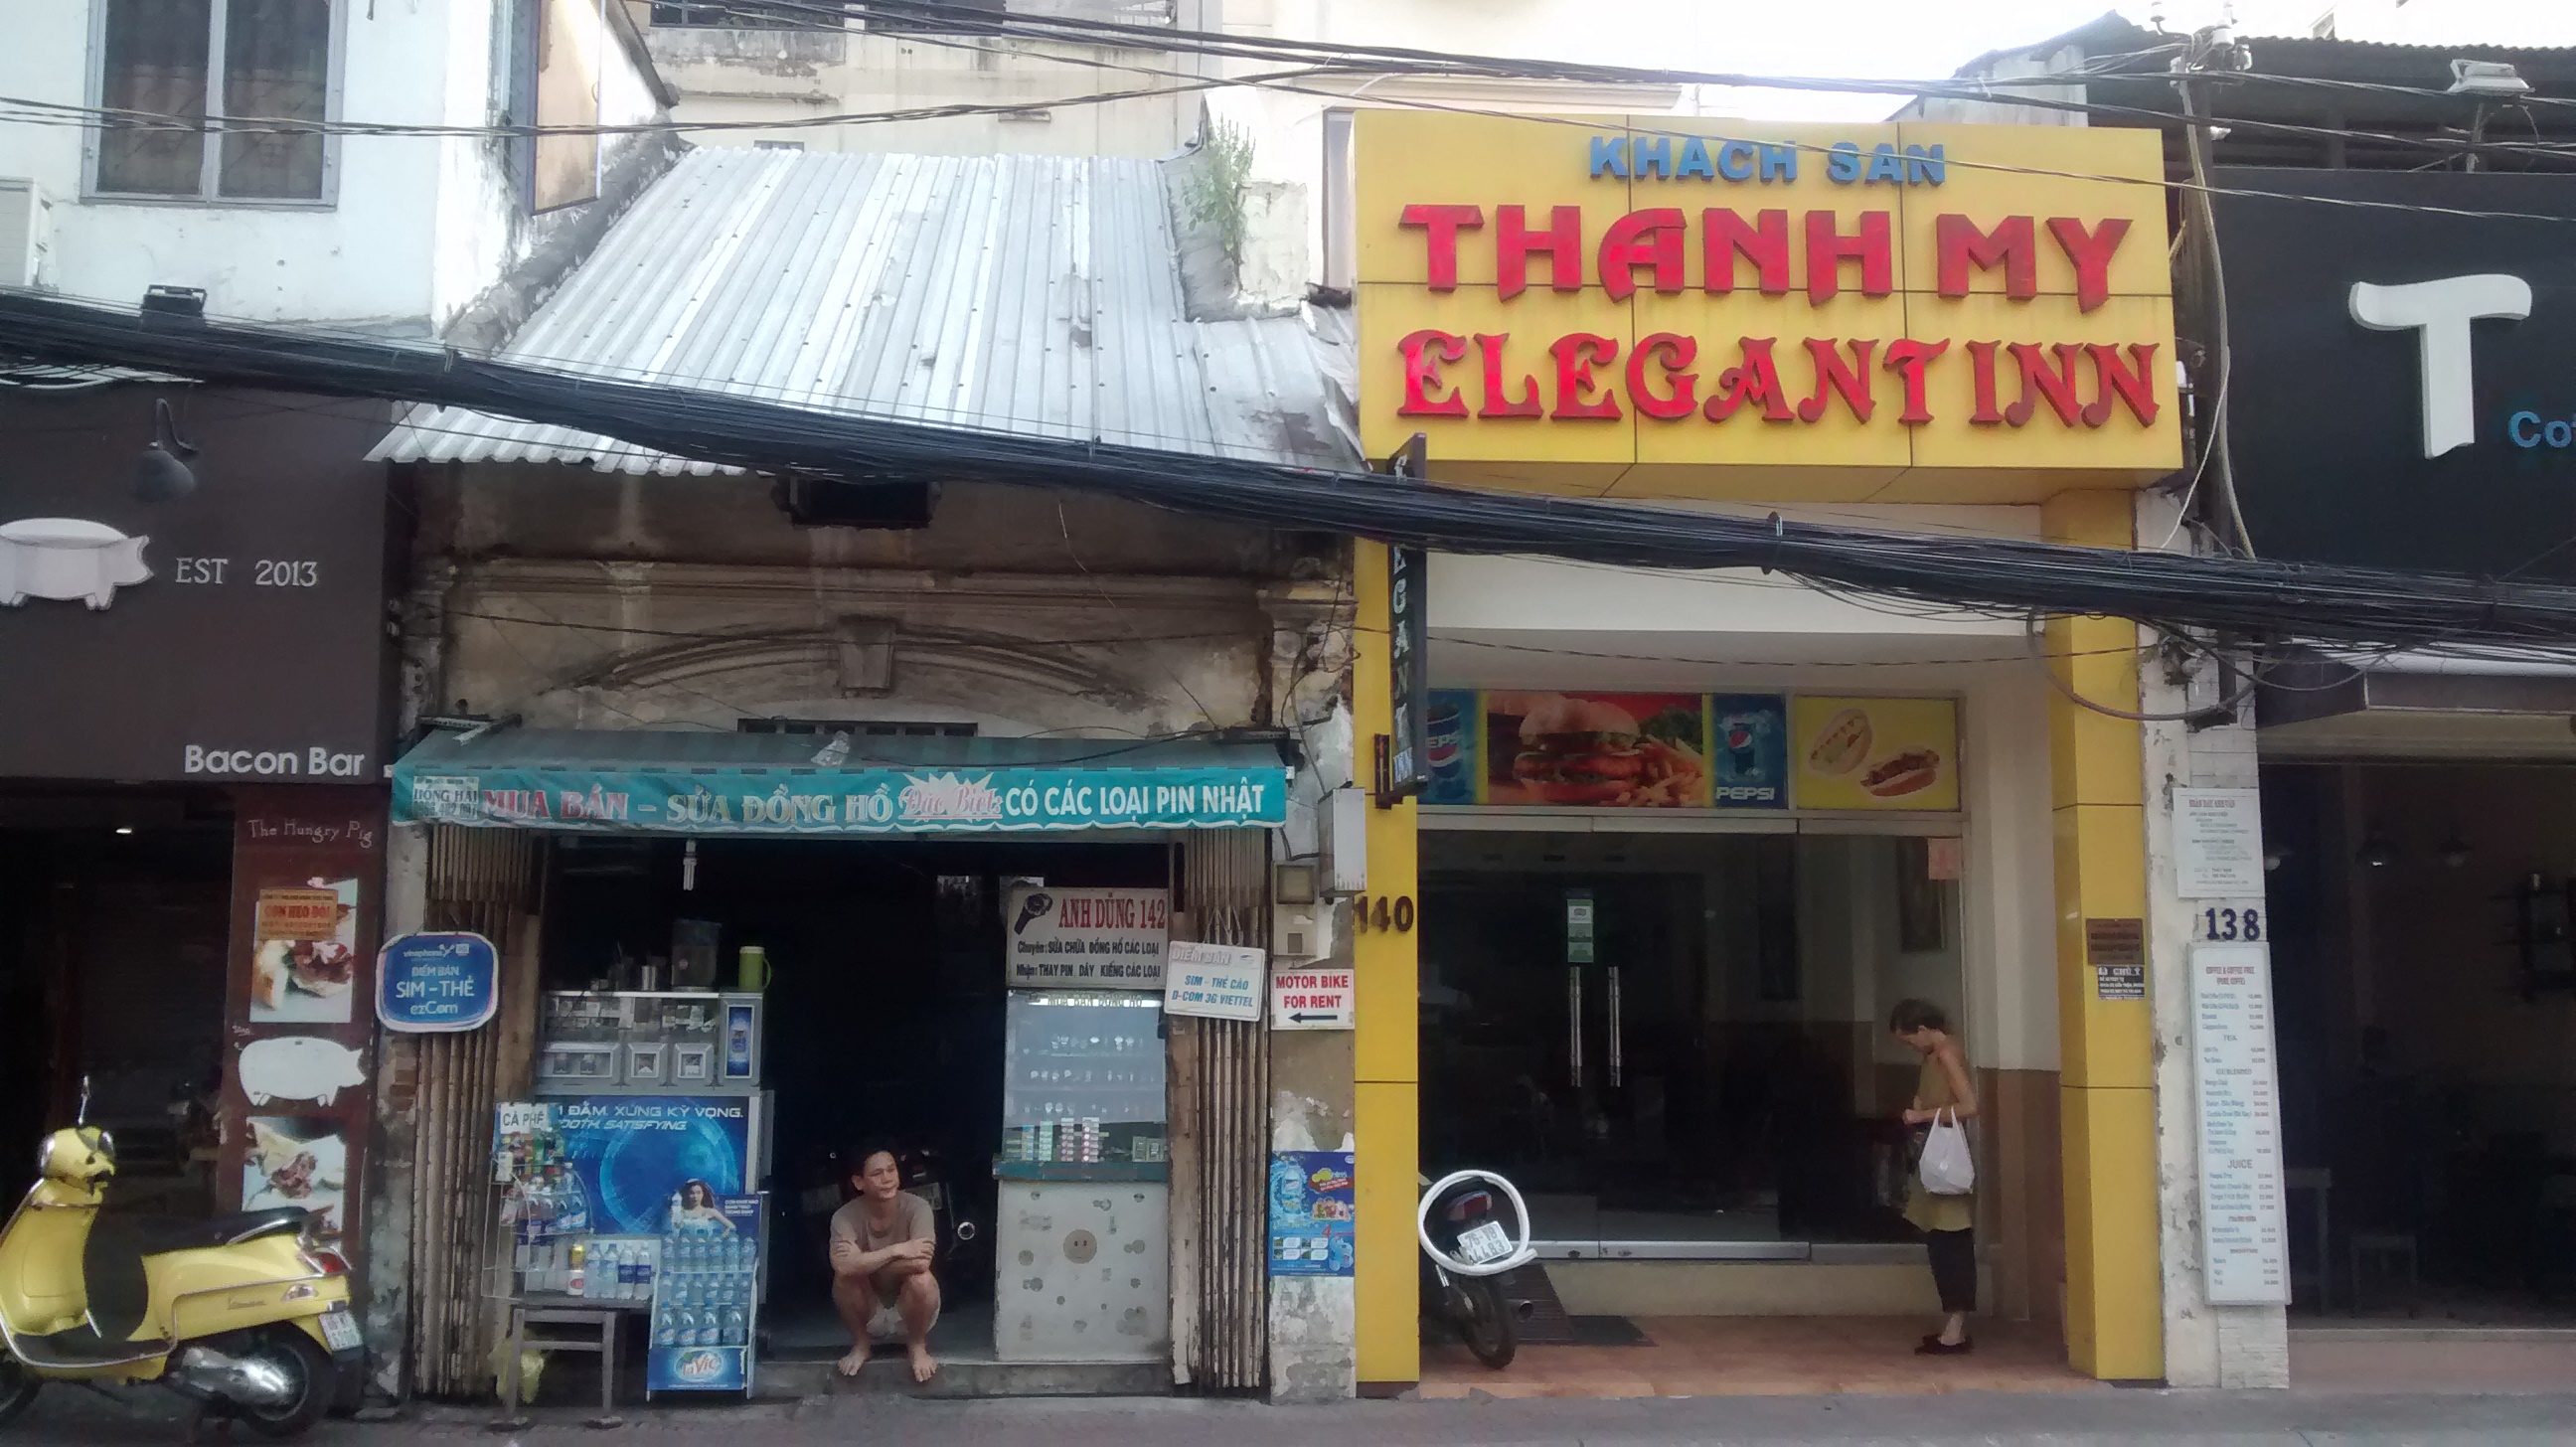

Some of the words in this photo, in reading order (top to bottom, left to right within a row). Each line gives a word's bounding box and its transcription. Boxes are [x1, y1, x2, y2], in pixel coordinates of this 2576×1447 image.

[1589, 135, 1798, 182] KHACH
[1827, 142, 1946, 186] SAN
[1398, 204, 1893, 307] THANH
[1935, 213, 2133, 314] MY
[1396, 328, 1950, 425] ELEGANT
[1967, 339, 2161, 428] INN
[2348, 273, 2532, 460] T
[2507, 410, 2576, 448] Co
[175, 558, 228, 584] EST
[254, 560, 318, 587] 2013
[184, 744, 298, 774] Bacon
[308, 747, 365, 776] Bar
[483, 789, 550, 819] MUA
[561, 783, 628, 821] BÁN
[740, 781, 836, 823] ĐỒNG
[845, 782, 893, 823] HỒ
[1006, 779, 1039, 816] CÓ
[1045, 778, 1092, 817] CÁC
[1100, 786, 1148, 822] LOẠI
[1156, 786, 1195, 814] PIN
[1202, 776, 1265, 820] NHẬT
[1715, 786, 1775, 801] PEPSI
[247, 819, 277, 839] The
[283, 819, 340, 844] Hungry
[345, 820, 374, 849] Pig
[1058, 898, 1091, 927] ANH
[1140, 898, 1165, 928] 142
[1355, 896, 1414, 933] 140
[2205, 907, 2260, 940] 138
[1124, 938, 1140, 955] CÁC
[1039, 964, 1059, 976] THAY
[1185, 975, 1204, 986] SIM
[1276, 975, 1317, 989] MOTOR
[1320, 975, 1349, 989] BIKE
[396, 981, 425, 998] SIM
[438, 975, 474, 997] THẺ
[1219, 994, 1253, 1007] VIETTEL
[409, 1001, 457, 1014] ezCom
[1283, 996, 1306, 1009] FOR
[1309, 996, 1342, 1009] RENT
[503, 1110, 520, 1126] CÀ
[2227, 1159, 2253, 1169] JUICE
